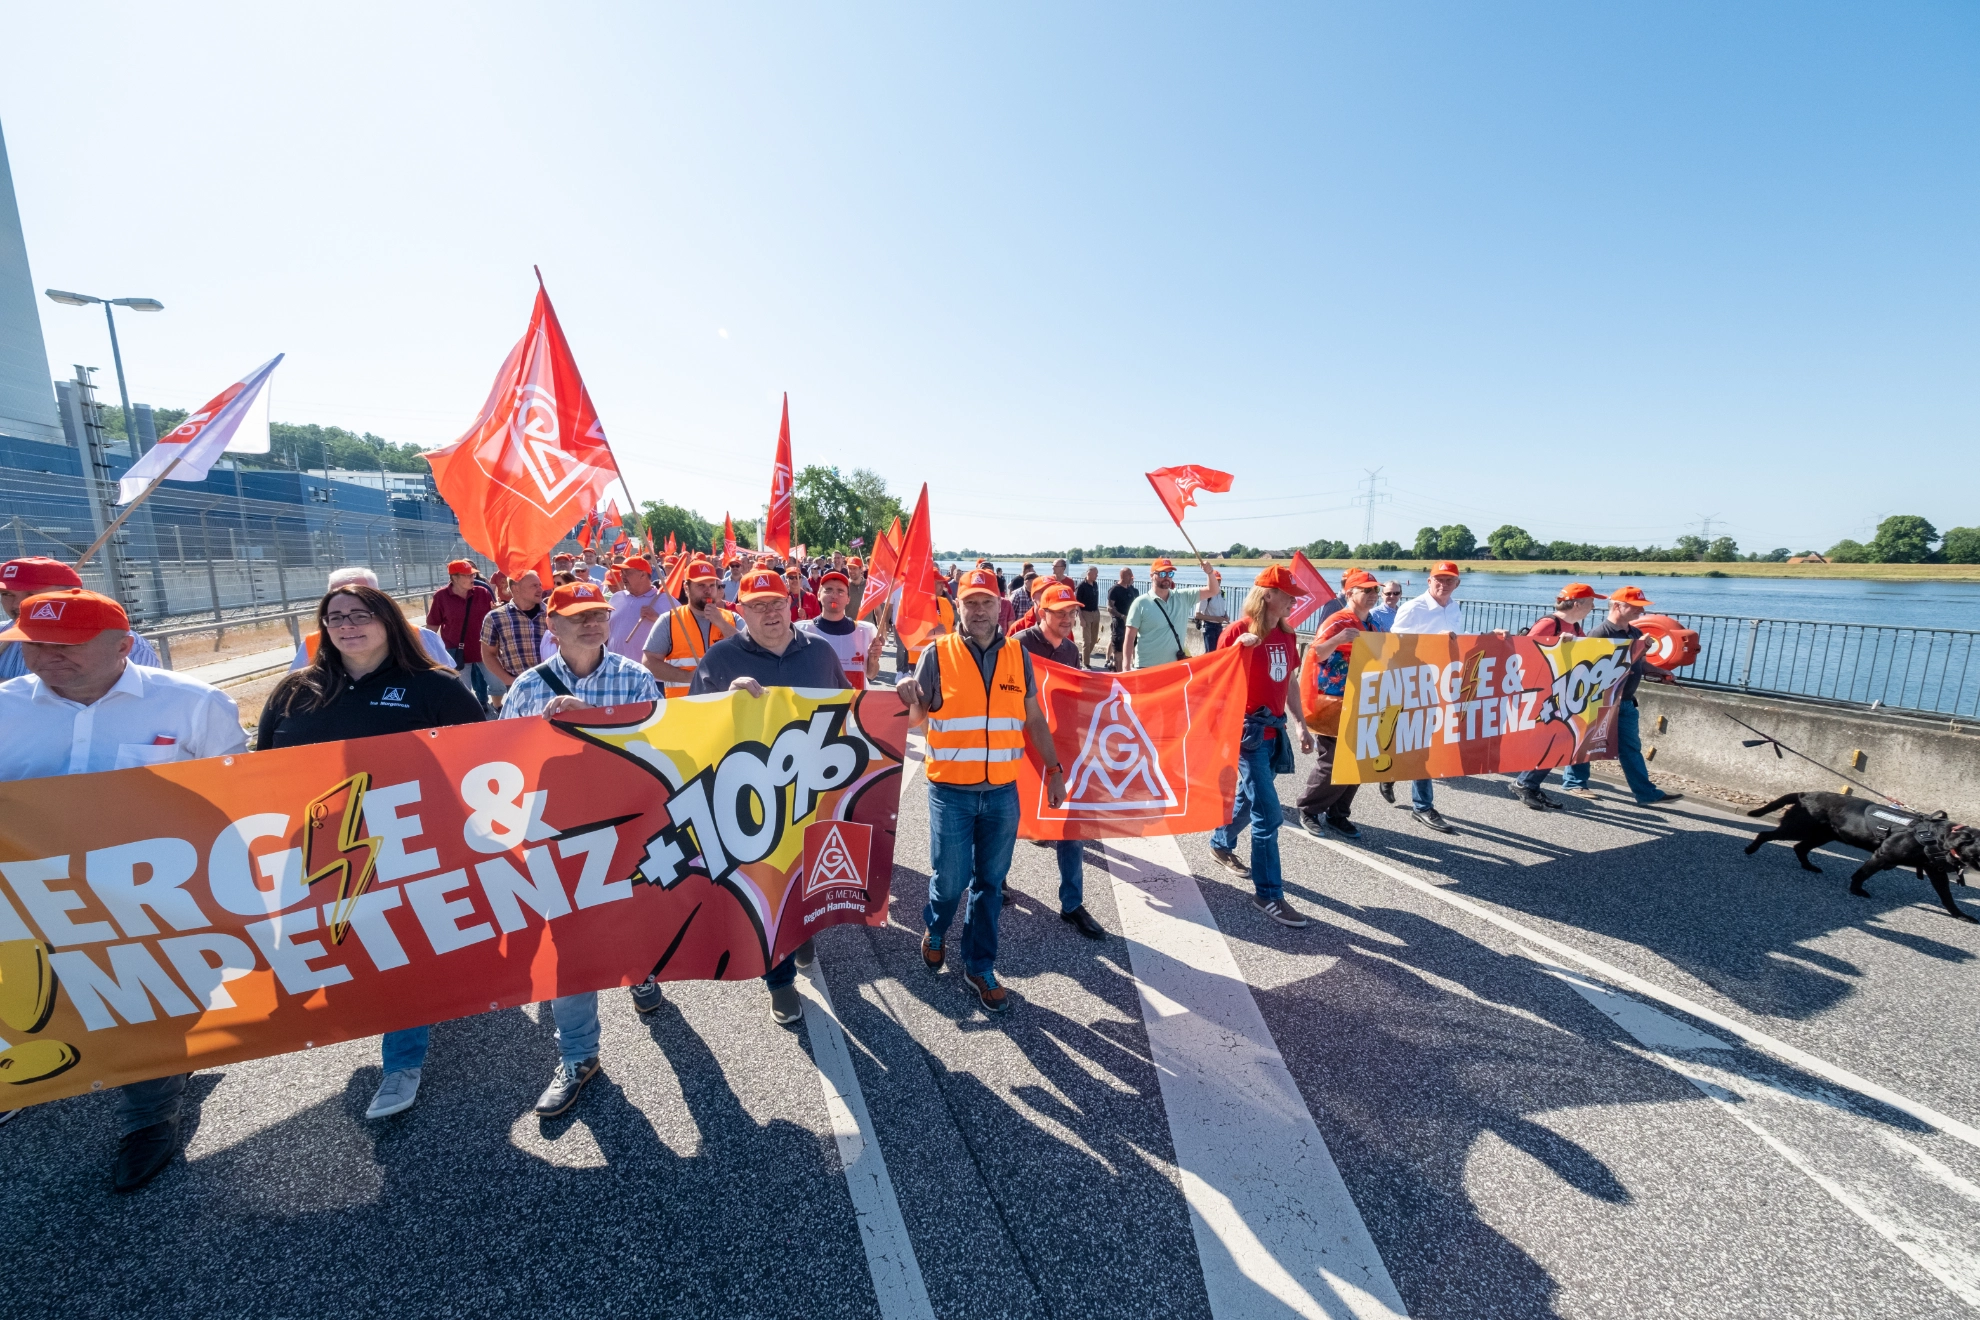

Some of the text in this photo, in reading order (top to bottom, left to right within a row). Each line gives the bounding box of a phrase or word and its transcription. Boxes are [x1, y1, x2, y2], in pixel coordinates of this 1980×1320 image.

[1502, 654, 1525, 694] &
[1540, 649, 1627, 723] +10%
[461, 761, 561, 853] &
[638, 706, 862, 888] +10%
[804, 901, 866, 925] Region Hamburg
[826, 889, 867, 901] IG METALL
